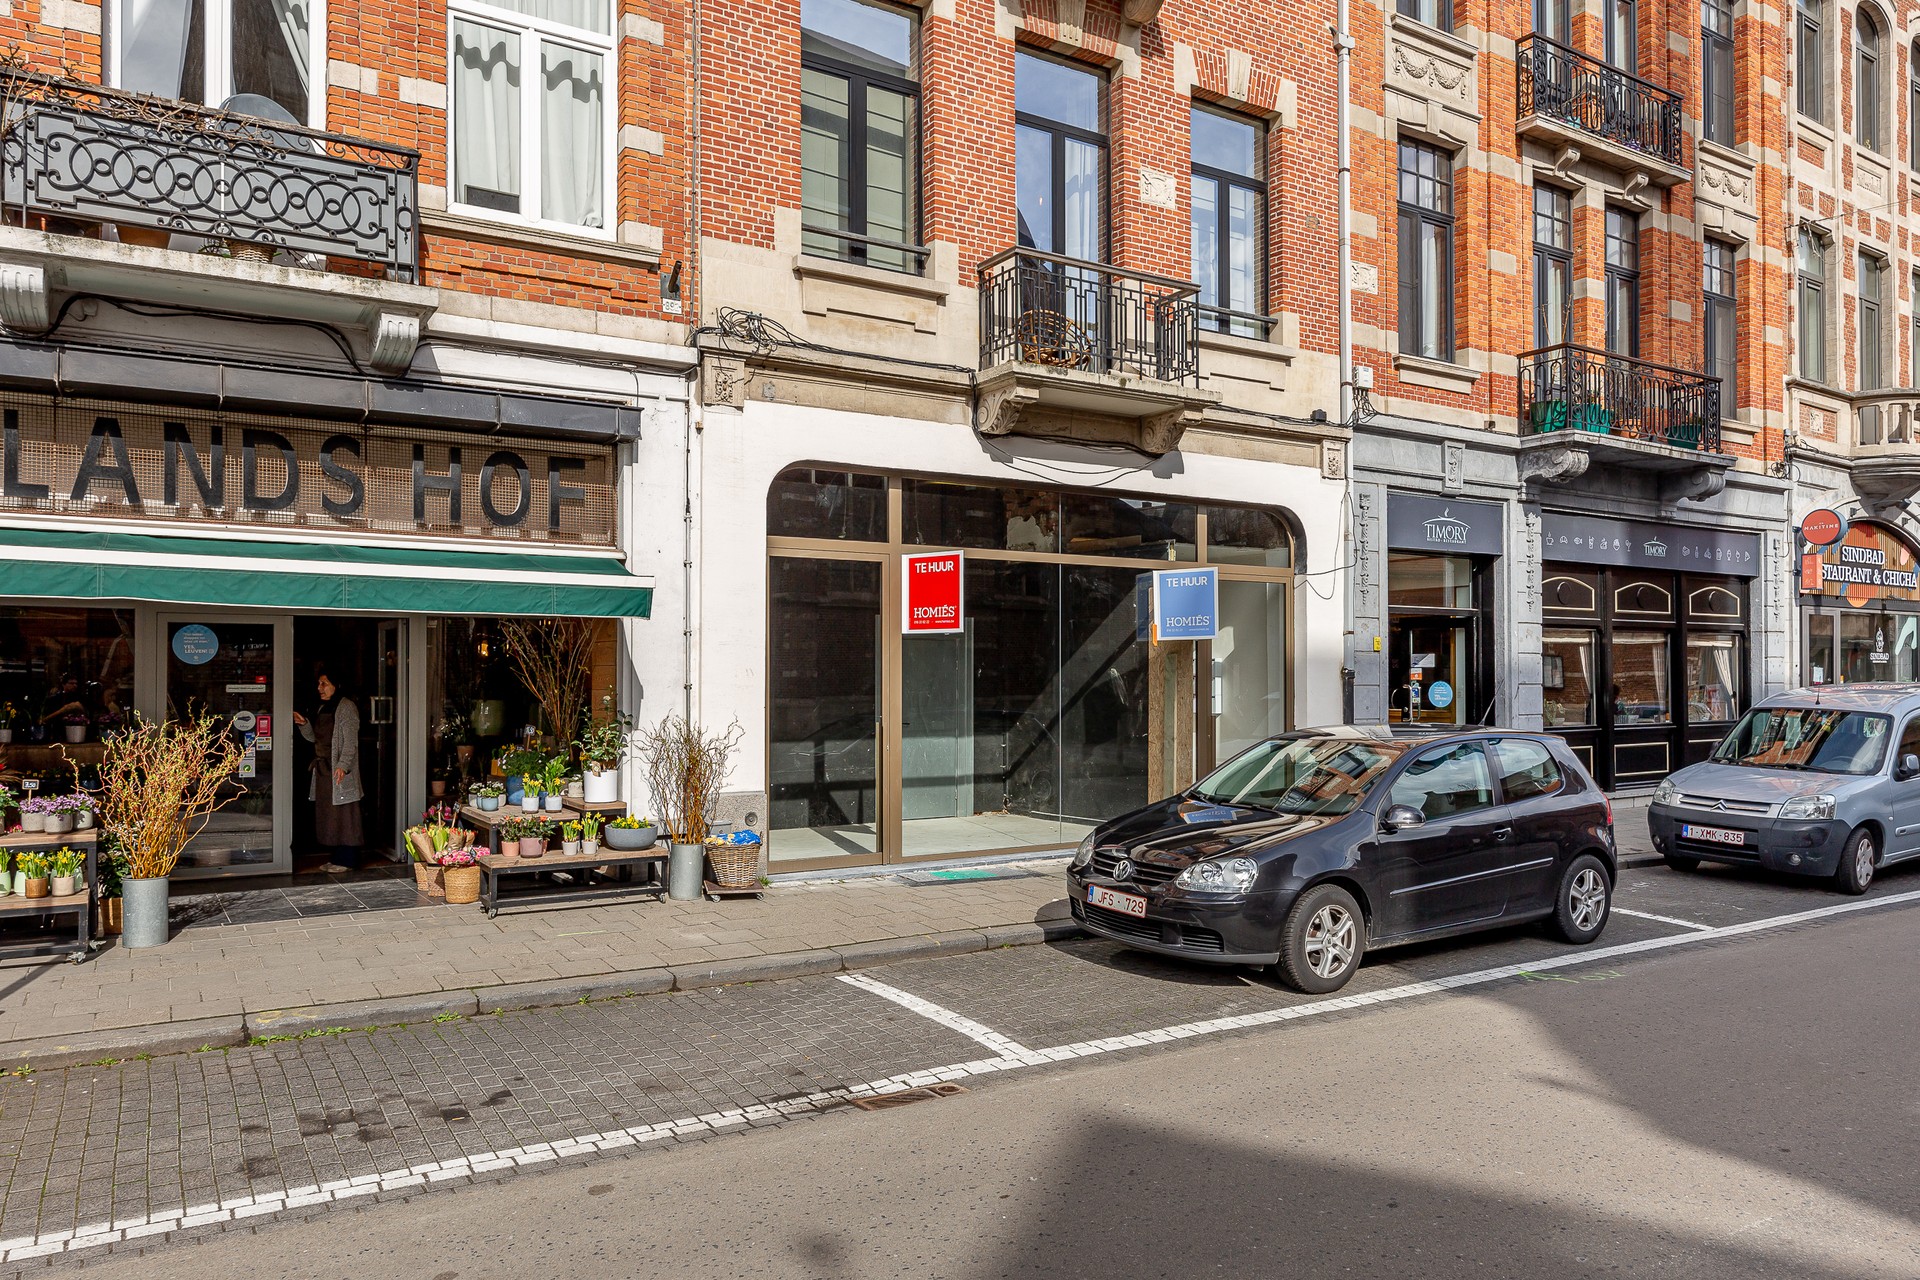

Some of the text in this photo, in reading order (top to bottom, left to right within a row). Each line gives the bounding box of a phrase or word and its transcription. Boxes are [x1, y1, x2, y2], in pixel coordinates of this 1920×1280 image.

[3, 409, 586, 531] LANDS HOF
[1424, 523, 1469, 541] TIMORY
[1644, 545, 1667, 555] TIMORY
[1841, 546, 1885, 565] SINDBAD
[914, 560, 954, 573] TE HUUR
[1166, 576, 1208, 587] TE HUUR
[1873, 569, 1881, 585] &
[1883, 570, 1918, 587] CHICHA
[913, 604, 956, 619] HOMIÉS
[1166, 614, 1210, 627] HOMIÉS
